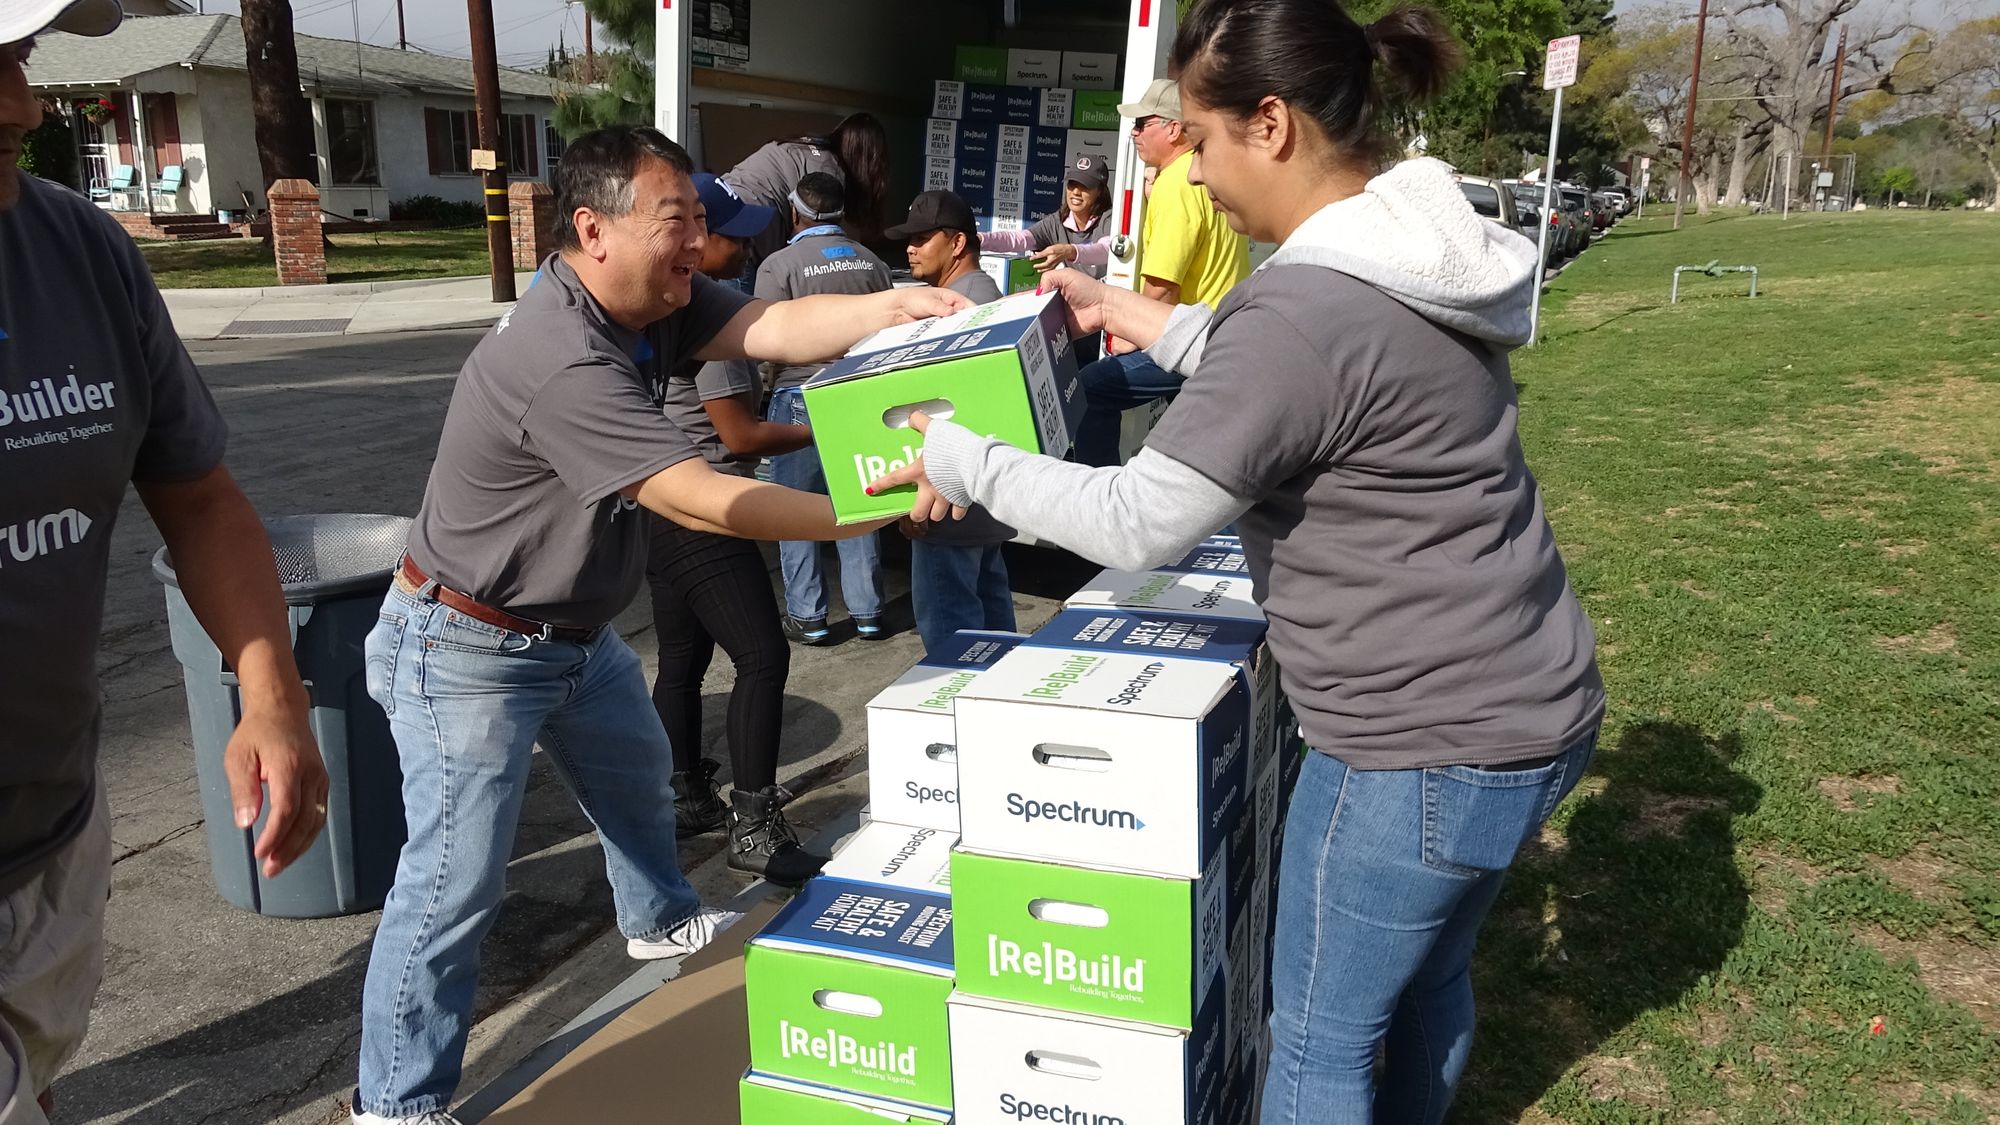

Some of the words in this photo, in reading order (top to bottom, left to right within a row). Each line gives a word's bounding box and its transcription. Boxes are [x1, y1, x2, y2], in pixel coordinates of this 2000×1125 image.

[962, 65, 997, 77] [Re]Build
[1017, 70, 1047, 80] Spectrum
[1072, 73, 1102, 83] Spectrum
[938, 95, 952, 104] SAFE
[937, 103, 957, 112] HEALTHY
[1047, 105, 1060, 114] SAFE
[1060, 105, 1065, 113] &
[1046, 112, 1065, 120] HEALTHY
[1082, 110, 1119, 123] [Re]Build
[931, 133, 944, 142] SAFE
[945, 134, 950, 142] &
[1003, 139, 1017, 149] SAFE
[1017, 140, 1022, 149] &
[1037, 136, 1061, 146] [Re]Build
[930, 142, 950, 150] HEALTHY
[1002, 148, 1022, 156] HEALTHY
[930, 171, 943, 179] SAFE
[944, 172, 949, 180] &
[962, 168, 986, 178] [Re]Build
[1033, 173, 1057, 183] [Re]Build
[929, 179, 949, 187] HEALTHY
[1000, 177, 1014, 186] SAFE
[1014, 178, 1019, 187] &
[999, 185, 1019, 194] HEALTHY
[998, 215, 1011, 224] SAFE
[1012, 216, 1017, 224] &
[997, 223, 1017, 231] HEALTHY
[803, 259, 874, 278] #IAmARebuilder
[4, 430, 69, 451] Rebuilding
[1192, 581, 1230, 609] Spectrum
[1122, 627, 1163, 646] SAFE
[1152, 621, 1194, 648] HEALTHY
[1178, 633, 1212, 650] HOME
[1022, 654, 1099, 699] [Re]Build
[918, 672, 976, 709] [Re]Build
[1107, 664, 1161, 706] Spectrum
[1211, 724, 1242, 789] [Re]Build
[1006, 793, 1137, 830] Spectrum
[1212, 784, 1238, 828] Spectrum
[885, 828, 936, 874] Spectrum
[823, 893, 861, 916] HOME
[834, 896, 884, 935] HEALTHY
[867, 900, 910, 928] SAFE
[811, 916, 840, 931] KIT
[912, 908, 952, 948] SPECTRUM
[857, 928, 886, 938] &
[988, 933, 1144, 993] [Re]Build
[1069, 983, 1108, 998] Rebuilding
[780, 1019, 916, 1076] [Re]Build
